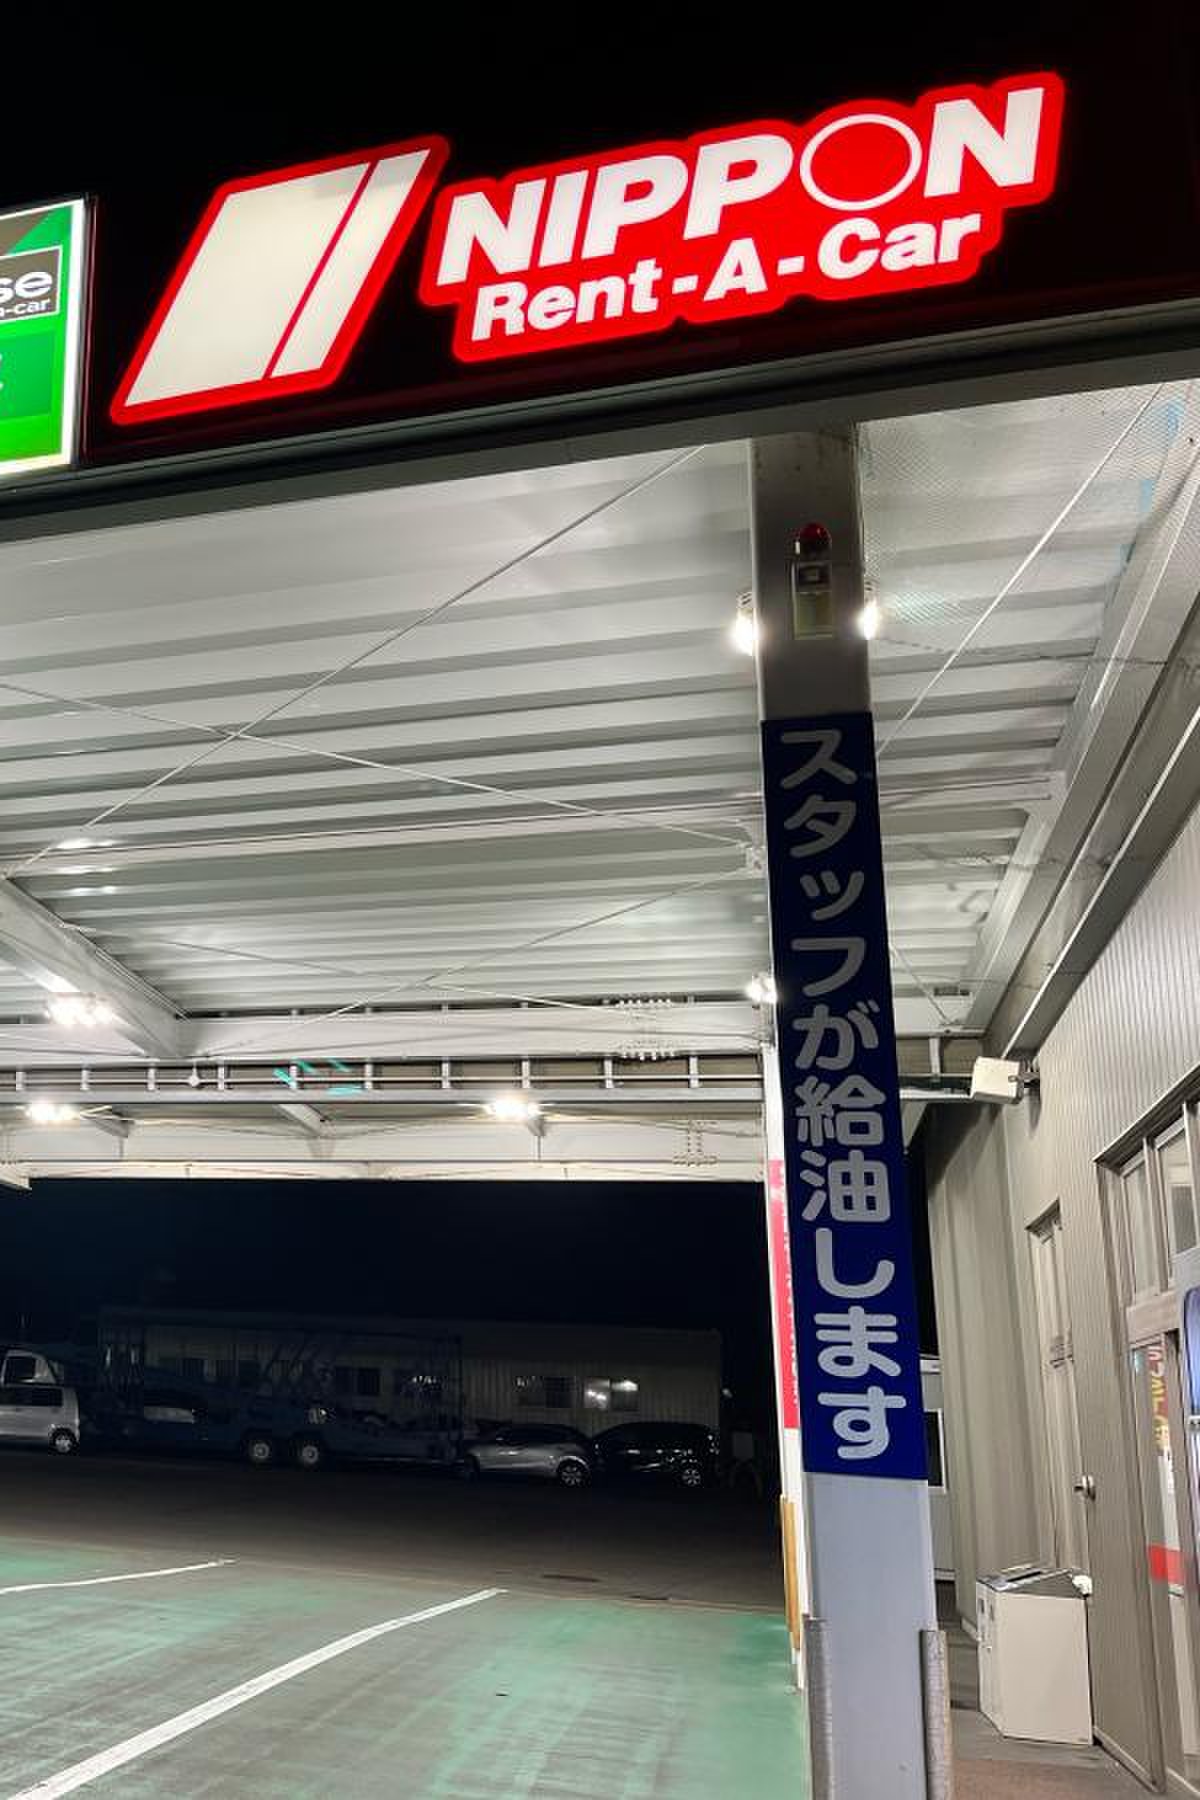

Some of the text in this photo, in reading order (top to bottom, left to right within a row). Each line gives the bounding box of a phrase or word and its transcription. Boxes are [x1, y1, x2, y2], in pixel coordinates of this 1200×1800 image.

[437, 87, 1044, 285] NIPPON
[780, 728, 907, 1460] スタッフが給油します
